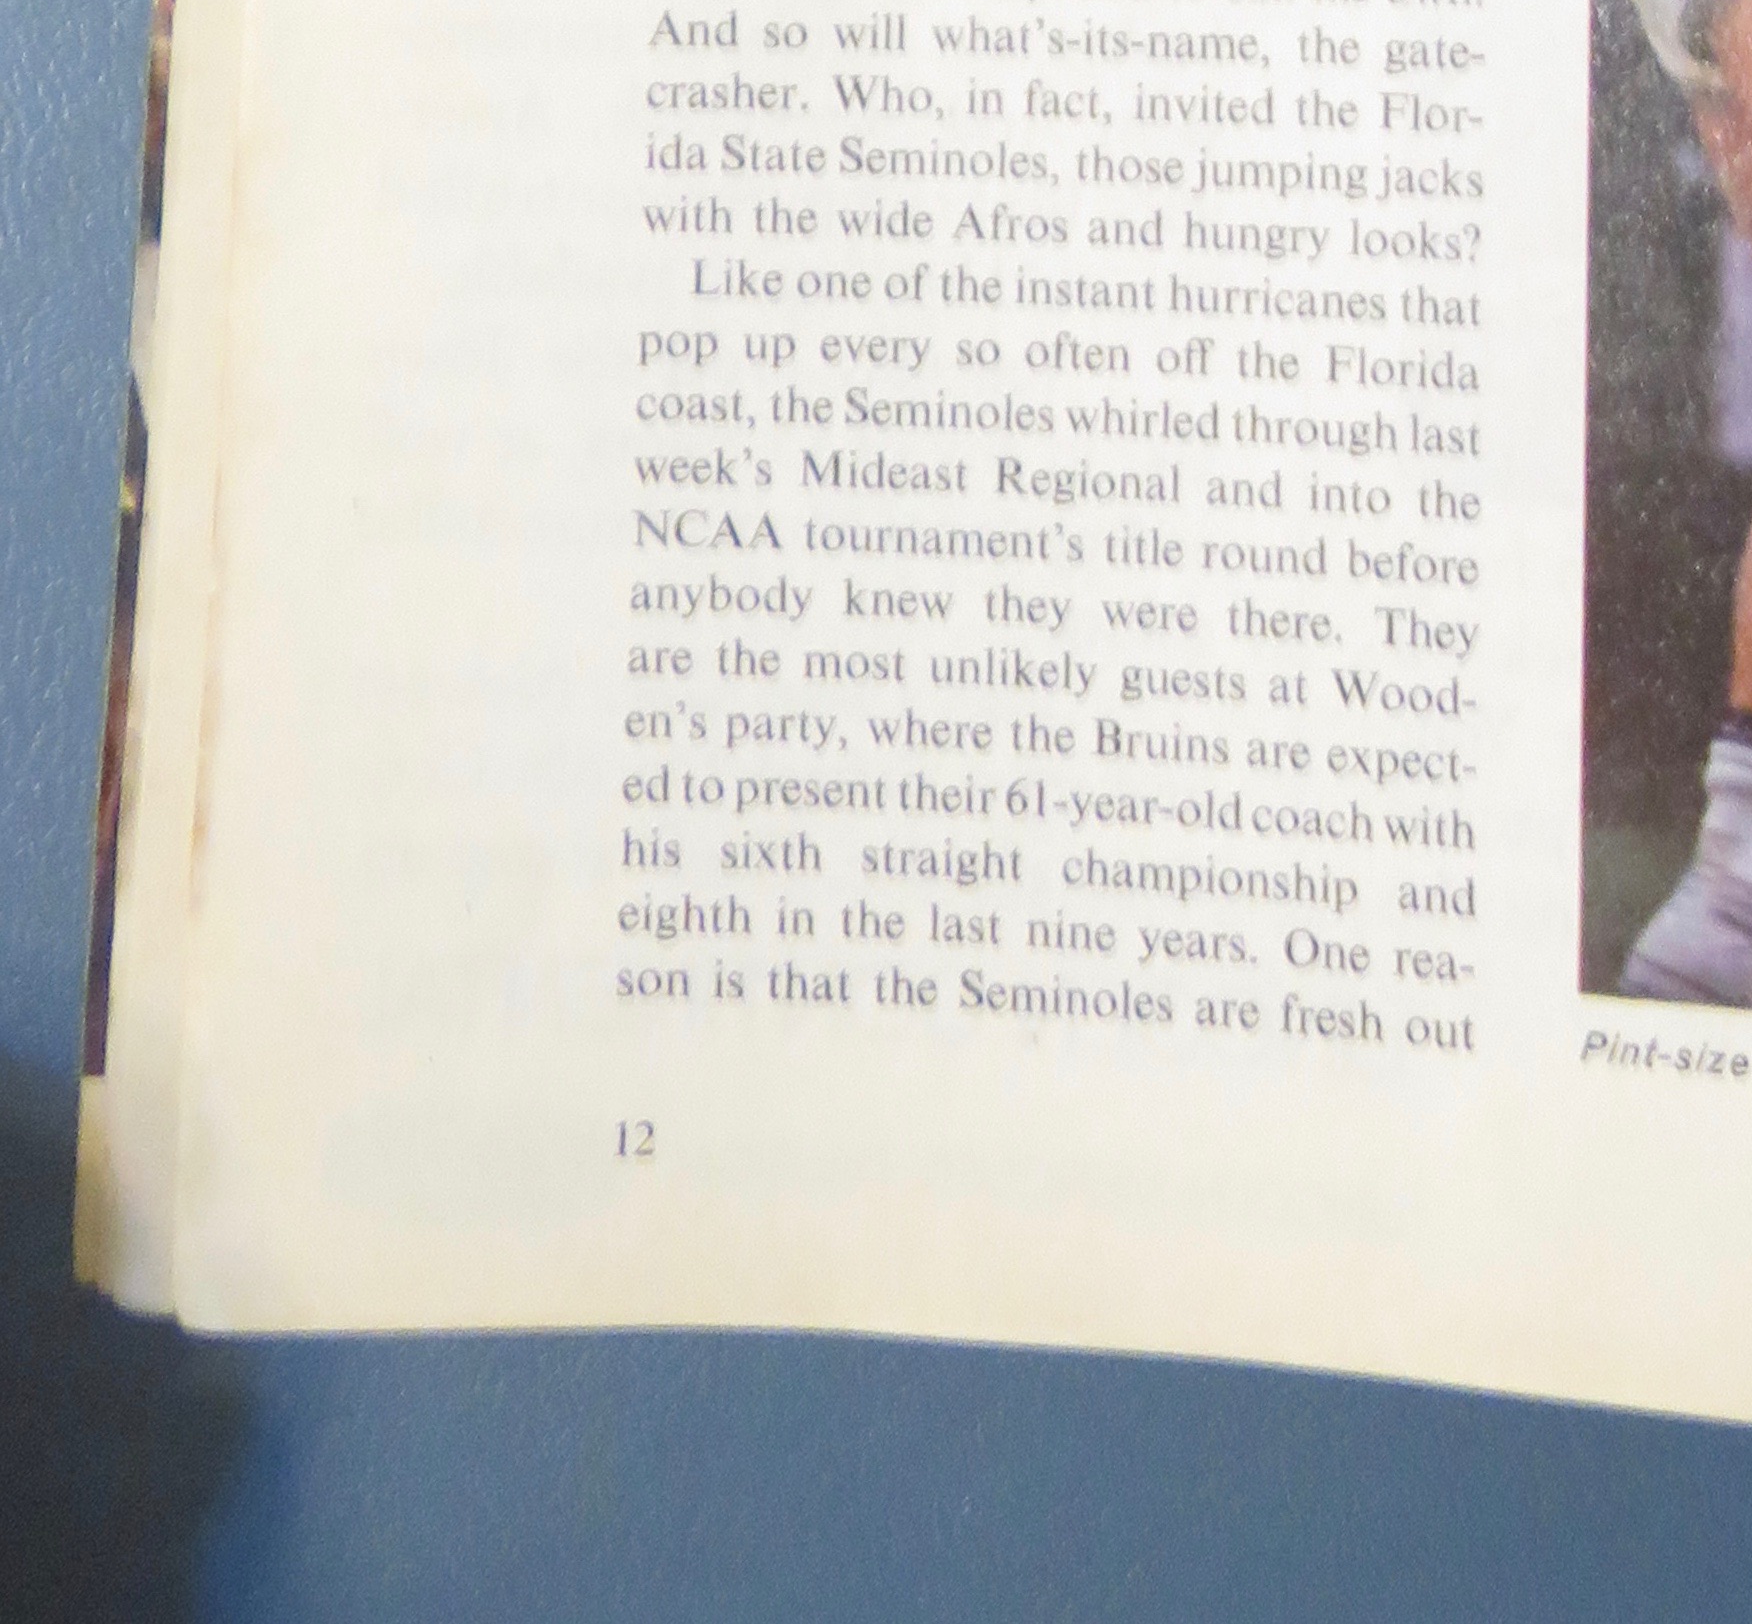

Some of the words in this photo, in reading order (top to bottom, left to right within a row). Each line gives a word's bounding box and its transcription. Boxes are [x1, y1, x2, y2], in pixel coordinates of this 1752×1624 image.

[644, 196, 732, 233] with
[755, 197, 817, 235] the
[839, 200, 933, 238] wide
[954, 204, 1068, 243] Afros
[1088, 210, 1163, 247] and
[1186, 211, 1328, 260] hungry
[1352, 219, 1481, 262] looks?
[623, 828, 681, 868] his
[722, 831, 821, 872] sixth
[863, 838, 1021, 888] straight
[1062, 848, 1358, 915] championship
[1399, 877, 1476, 917] and
[1581, 1031, 1749, 1077] Pint-size
[617, 1120, 654, 1157] 12
